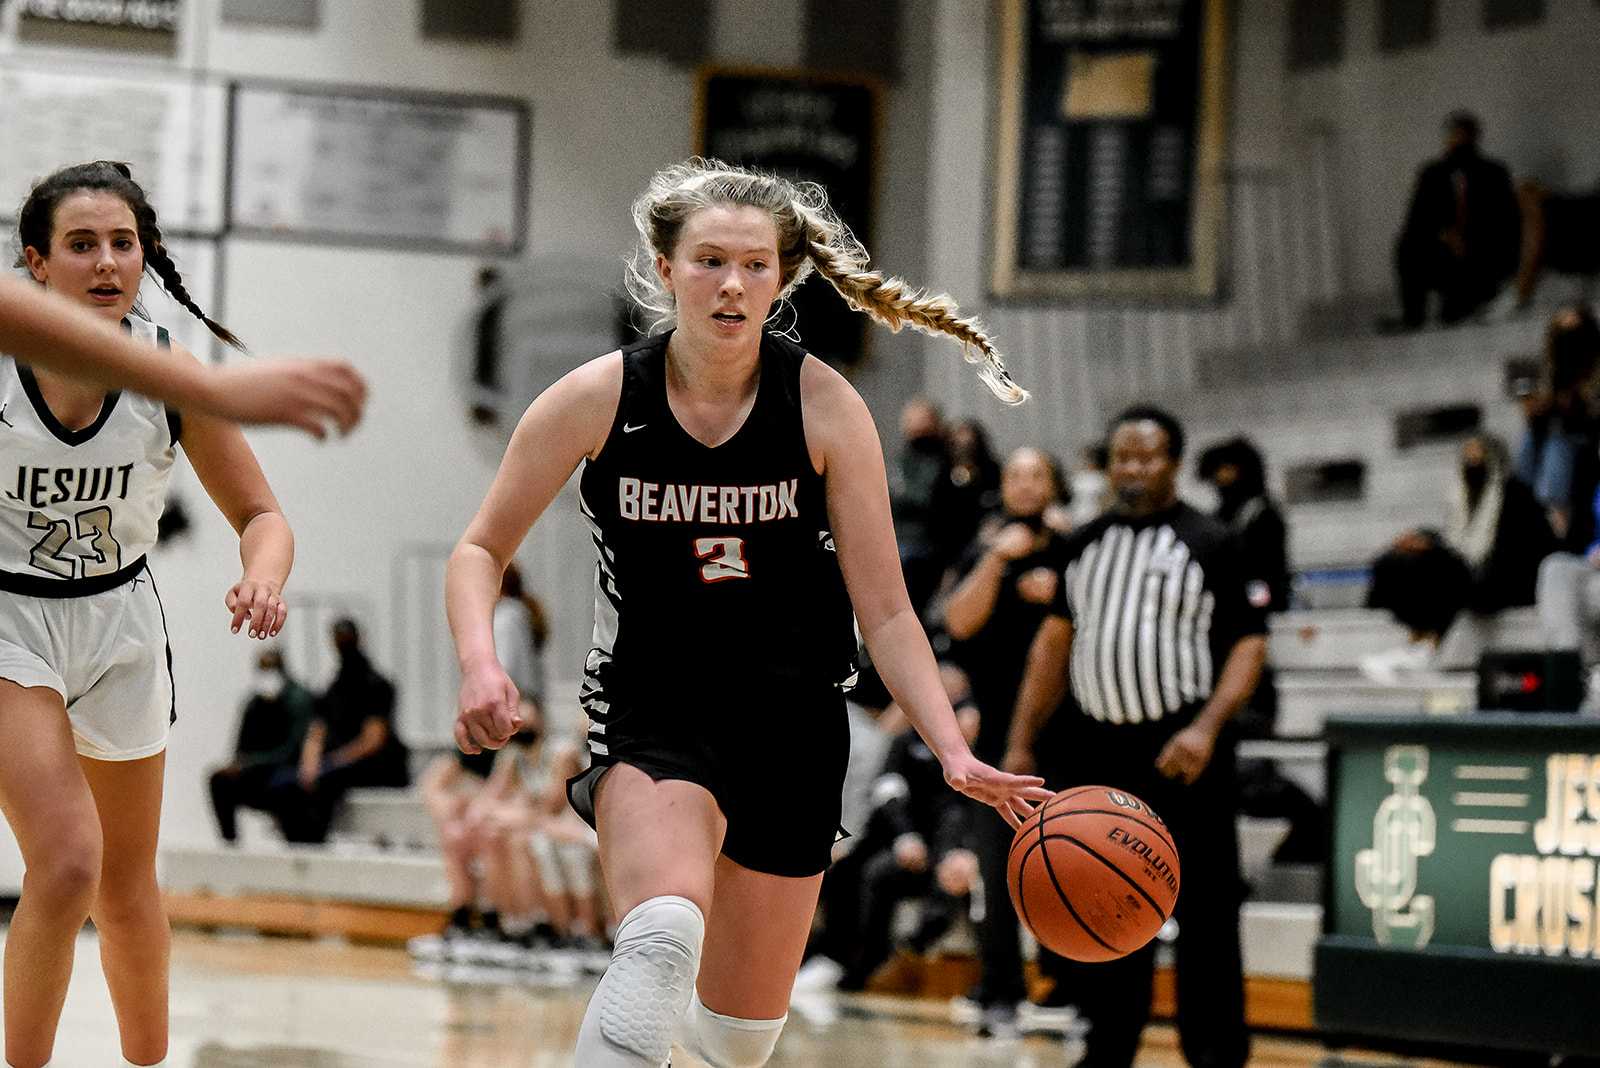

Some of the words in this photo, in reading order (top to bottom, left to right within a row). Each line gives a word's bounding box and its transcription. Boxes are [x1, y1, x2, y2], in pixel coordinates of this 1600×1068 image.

[5, 462, 134, 508] JESUIT
[618, 476, 799, 525] BEAVERTON
[27, 505, 122, 580] 23
[1489, 853, 1600, 959] CRUS
